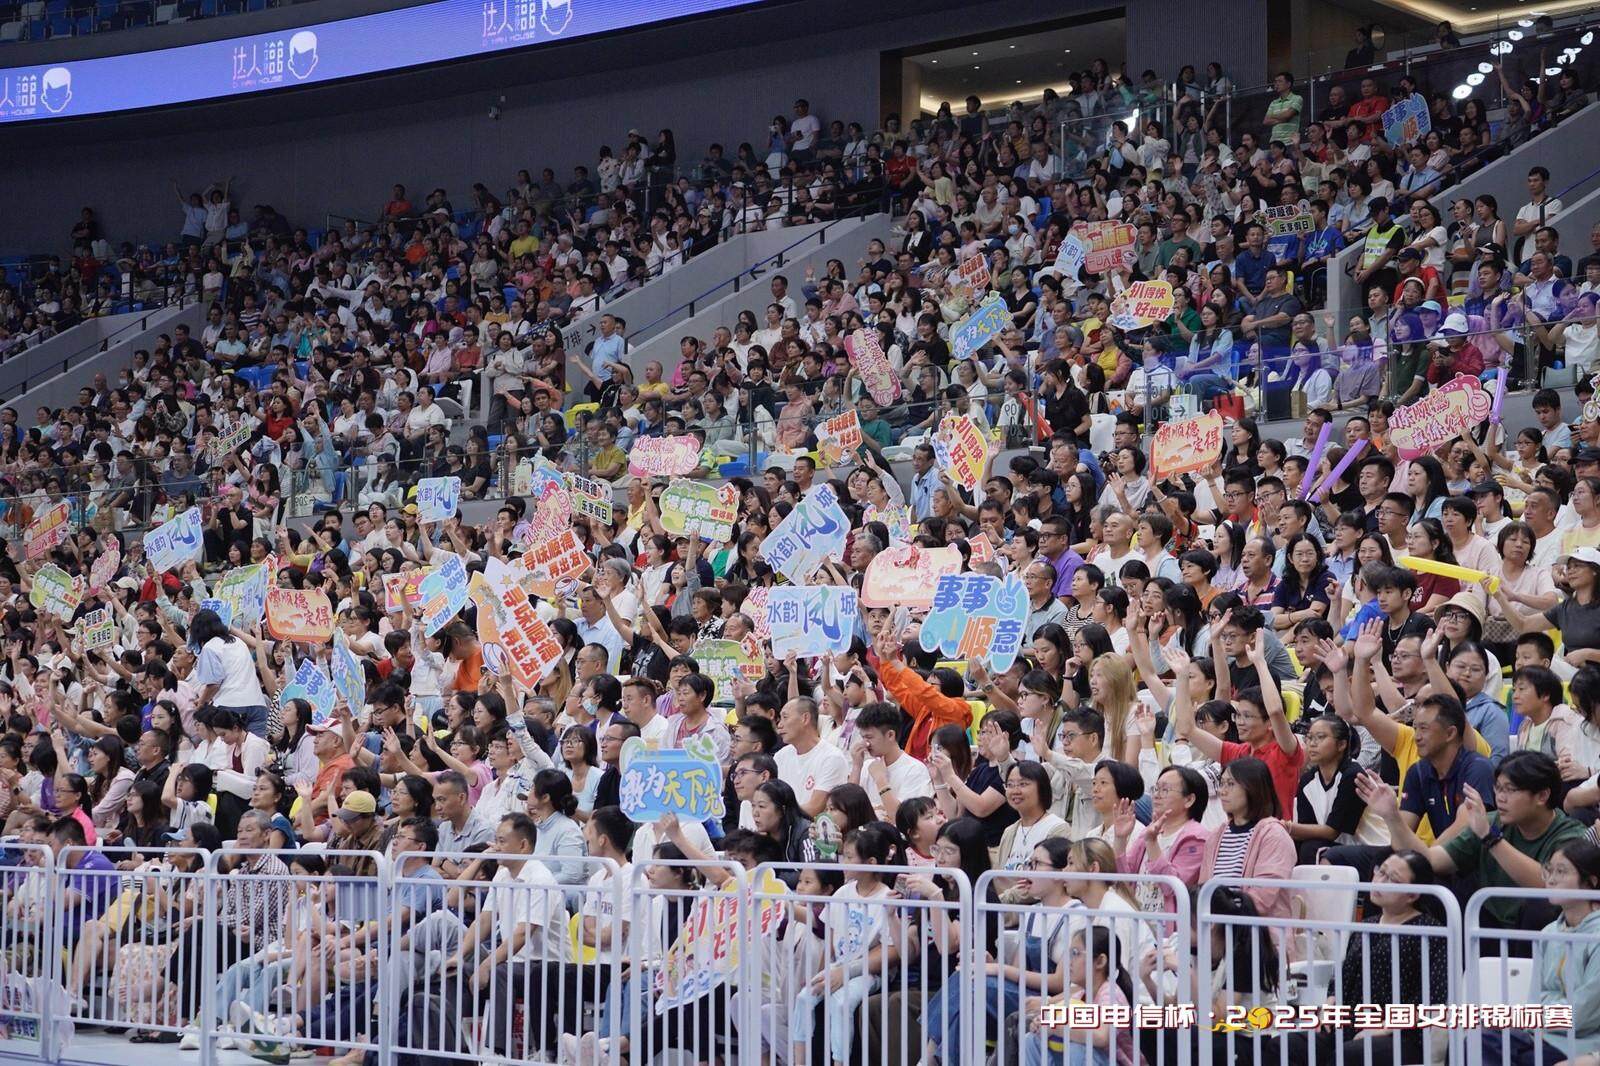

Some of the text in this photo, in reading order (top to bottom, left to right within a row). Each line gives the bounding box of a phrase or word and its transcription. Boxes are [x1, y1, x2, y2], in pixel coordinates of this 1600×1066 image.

[1279, 221, 1309, 233] 乐享假日
[1128, 282, 1168, 300] 扒得快
[1132, 301, 1171, 319] 好世界
[956, 414, 984, 464] 扒得快
[950, 443, 977, 490] 好世界
[581, 500, 608, 521] 乐享假日
[523, 529, 577, 571] 寻味顺德
[934, 574, 993, 615] 事事
[502, 585, 564, 665] 寻味顺德
[958, 617, 1022, 661] 顺意
[295, 659, 326, 696] 事事
[621, 765, 723, 815] 敢为天下先
